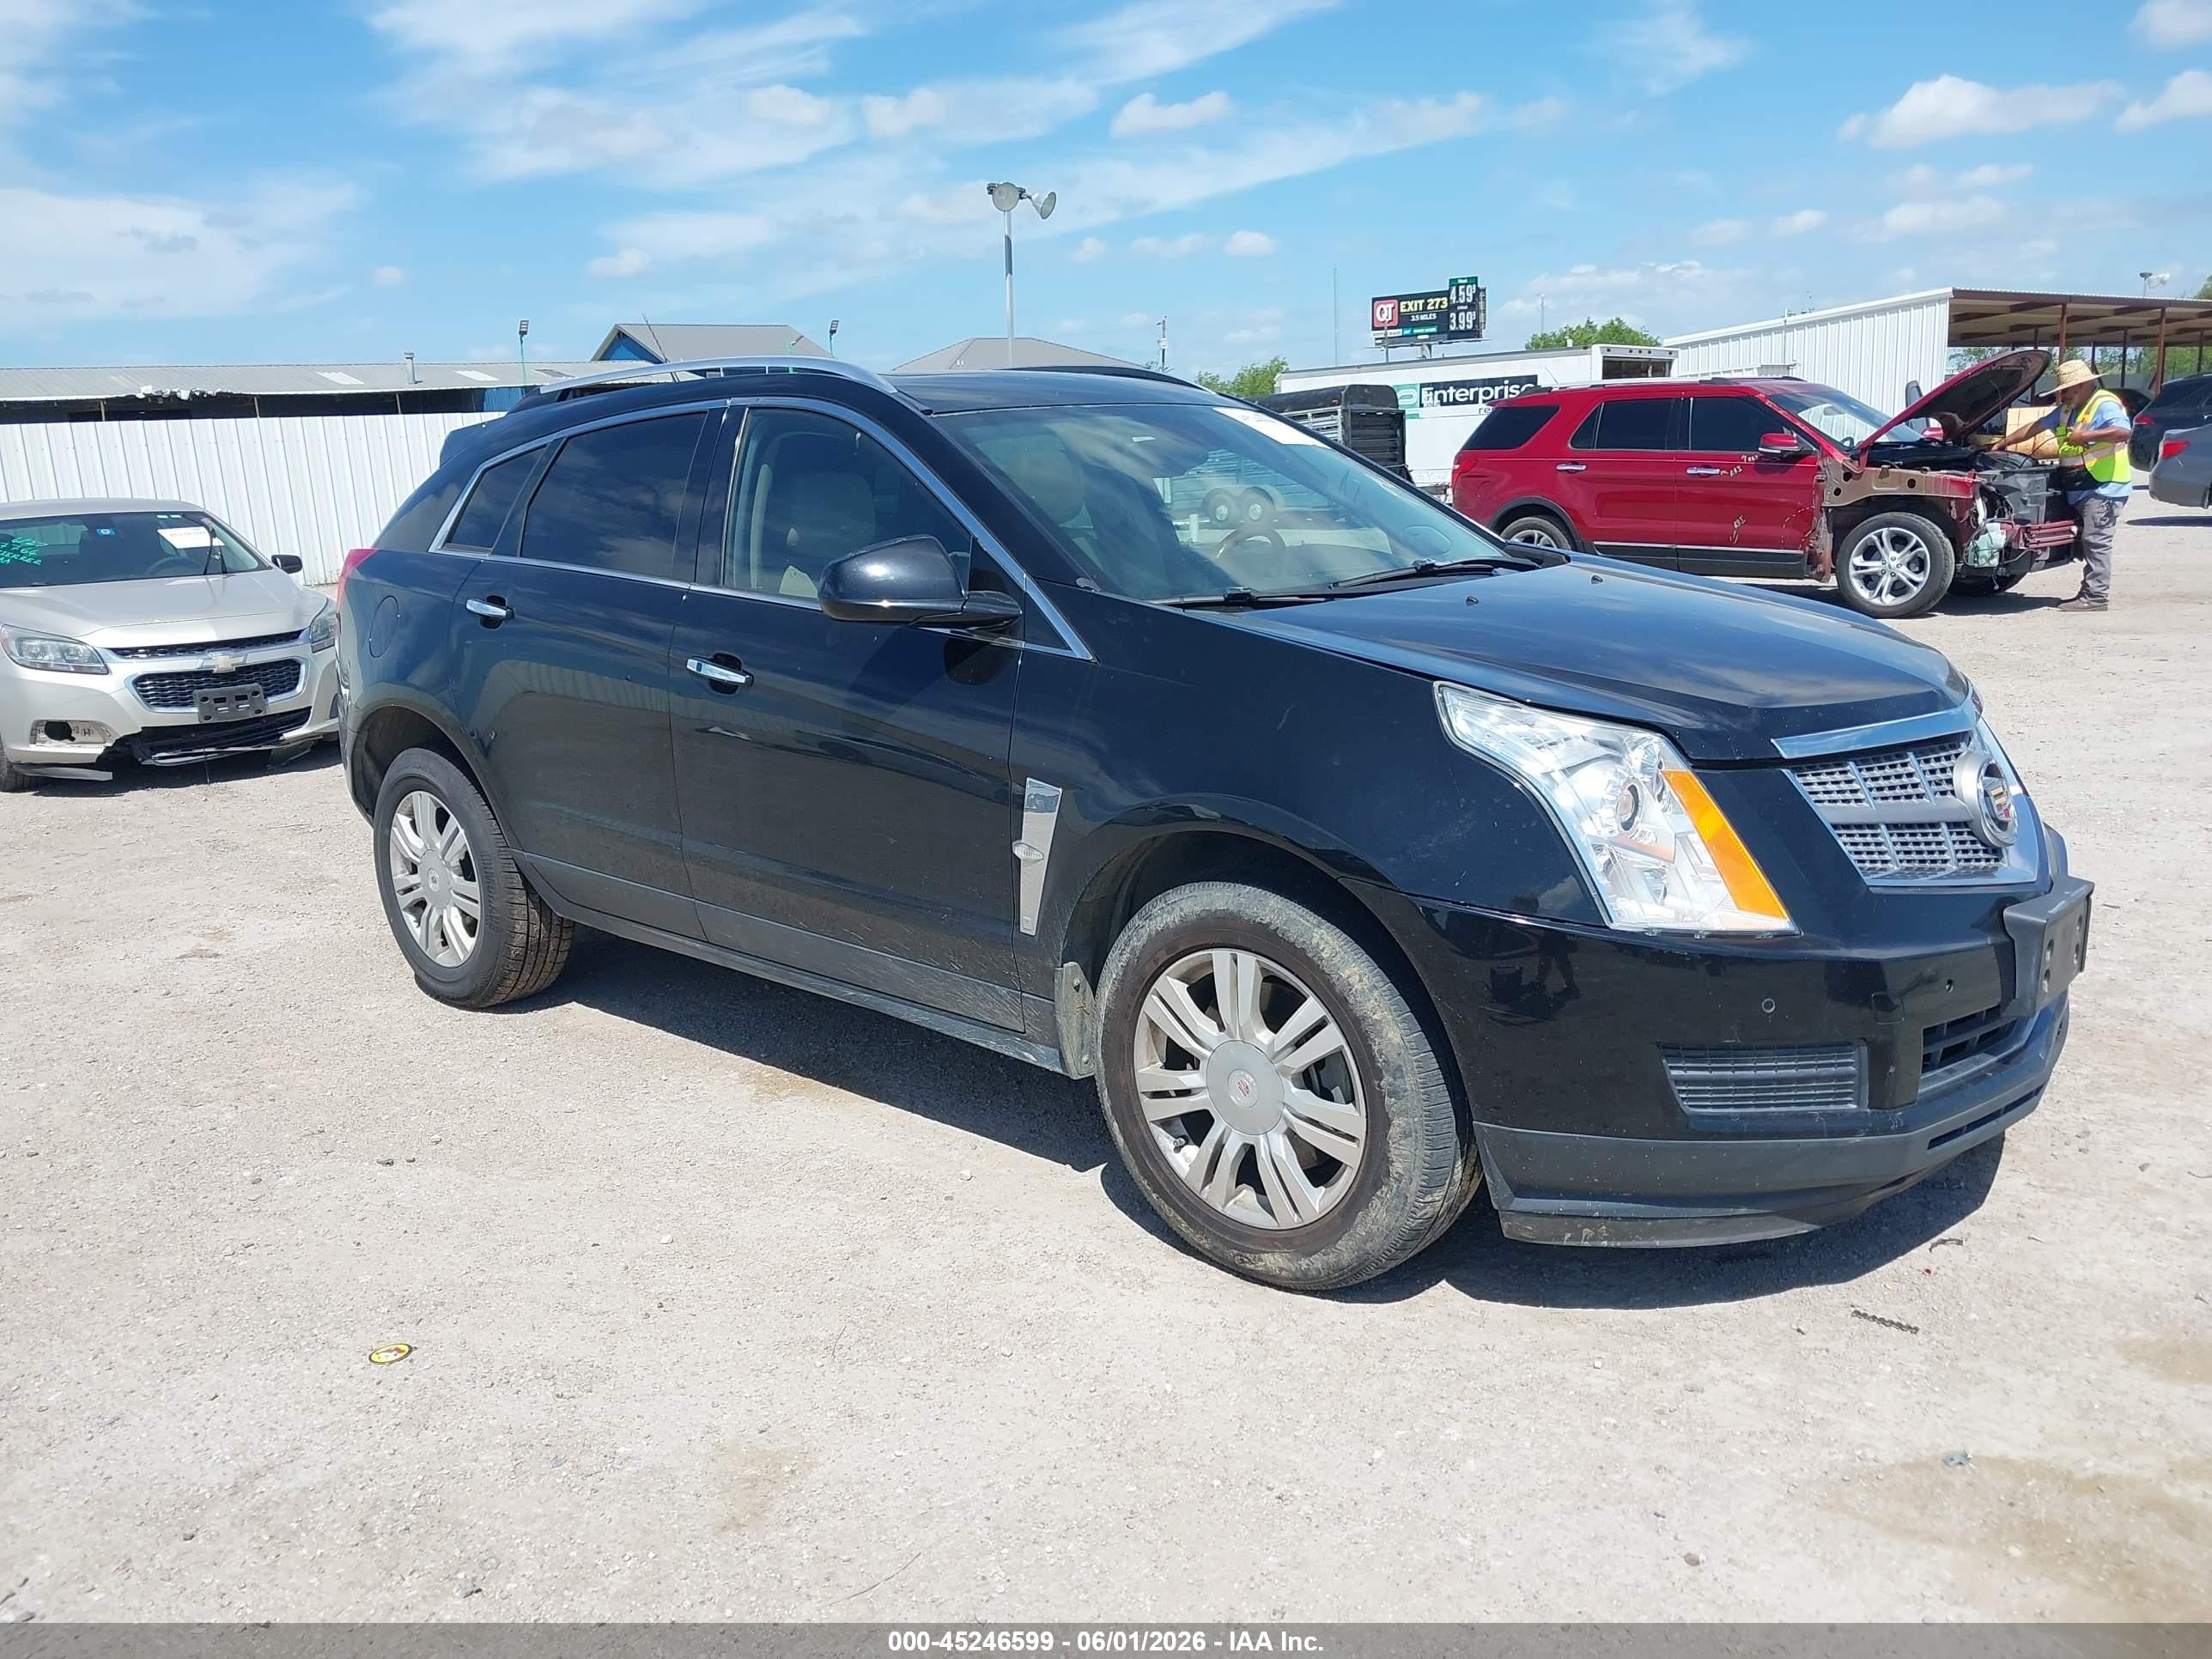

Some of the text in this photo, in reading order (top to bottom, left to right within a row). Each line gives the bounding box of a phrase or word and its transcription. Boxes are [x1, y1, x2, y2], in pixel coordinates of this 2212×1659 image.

[1376, 303, 1395, 323] QT
[1400, 297, 1448, 313] EXIT 273
